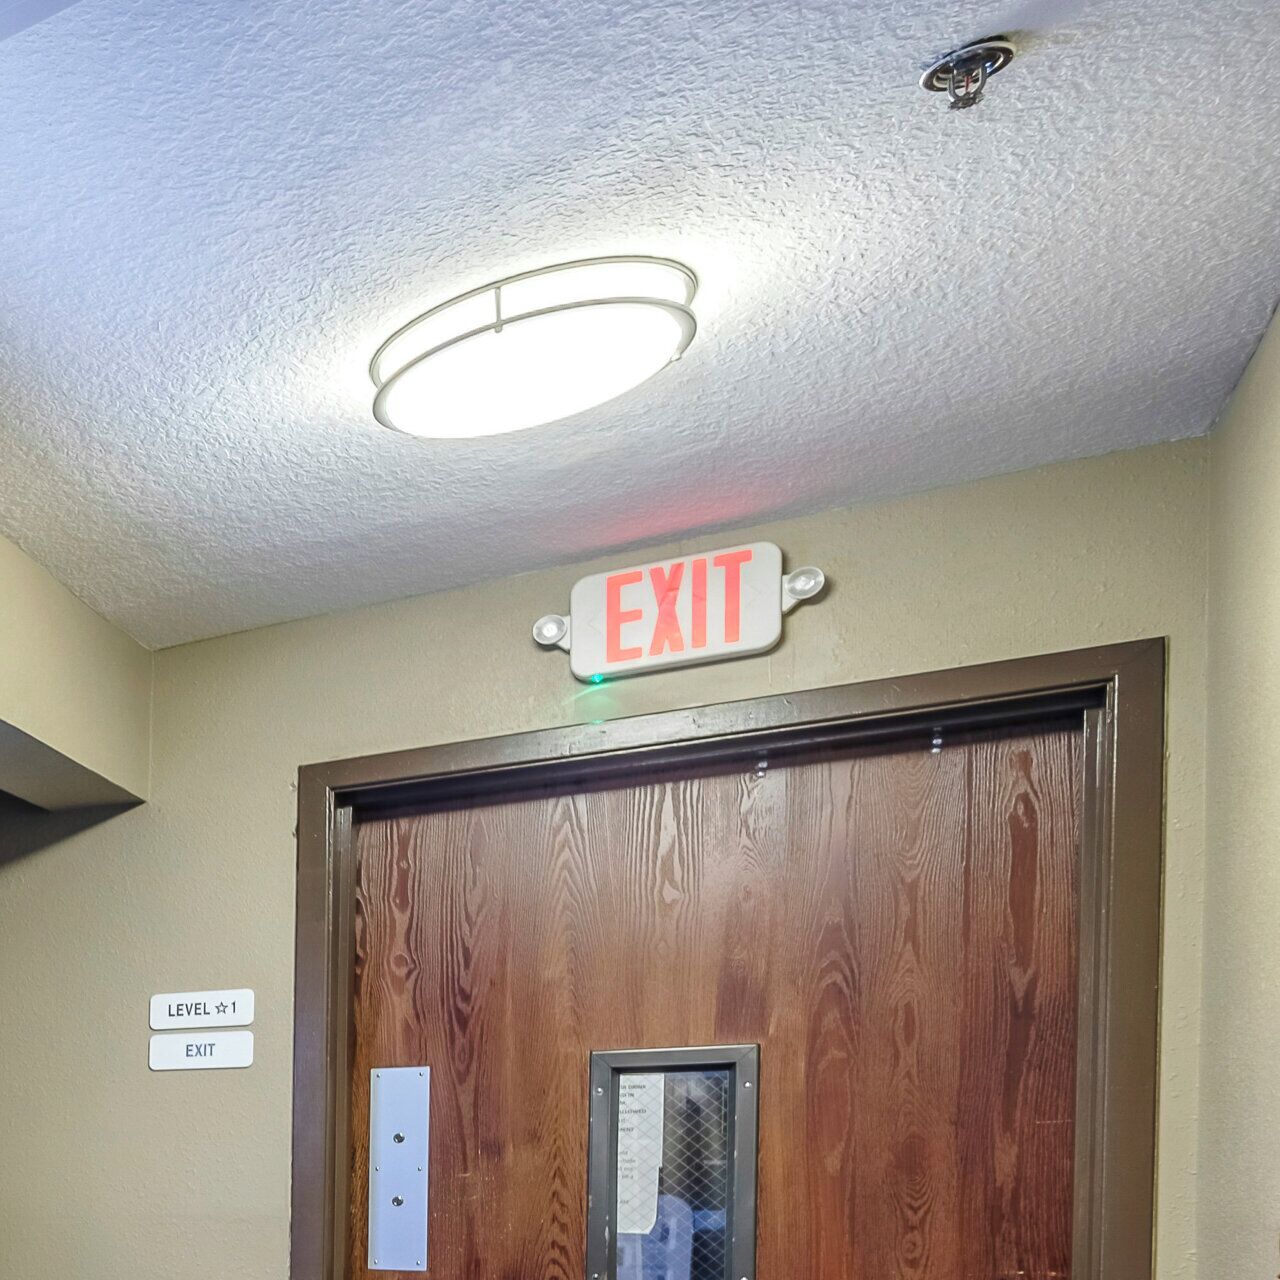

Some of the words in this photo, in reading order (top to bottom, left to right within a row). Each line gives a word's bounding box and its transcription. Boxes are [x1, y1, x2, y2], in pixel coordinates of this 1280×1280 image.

[605, 549, 753, 664] EXIT
[168, 1002, 210, 1017] LEVEL
[231, 1000, 237, 1014] 1
[185, 1043, 216, 1058] EXIT
